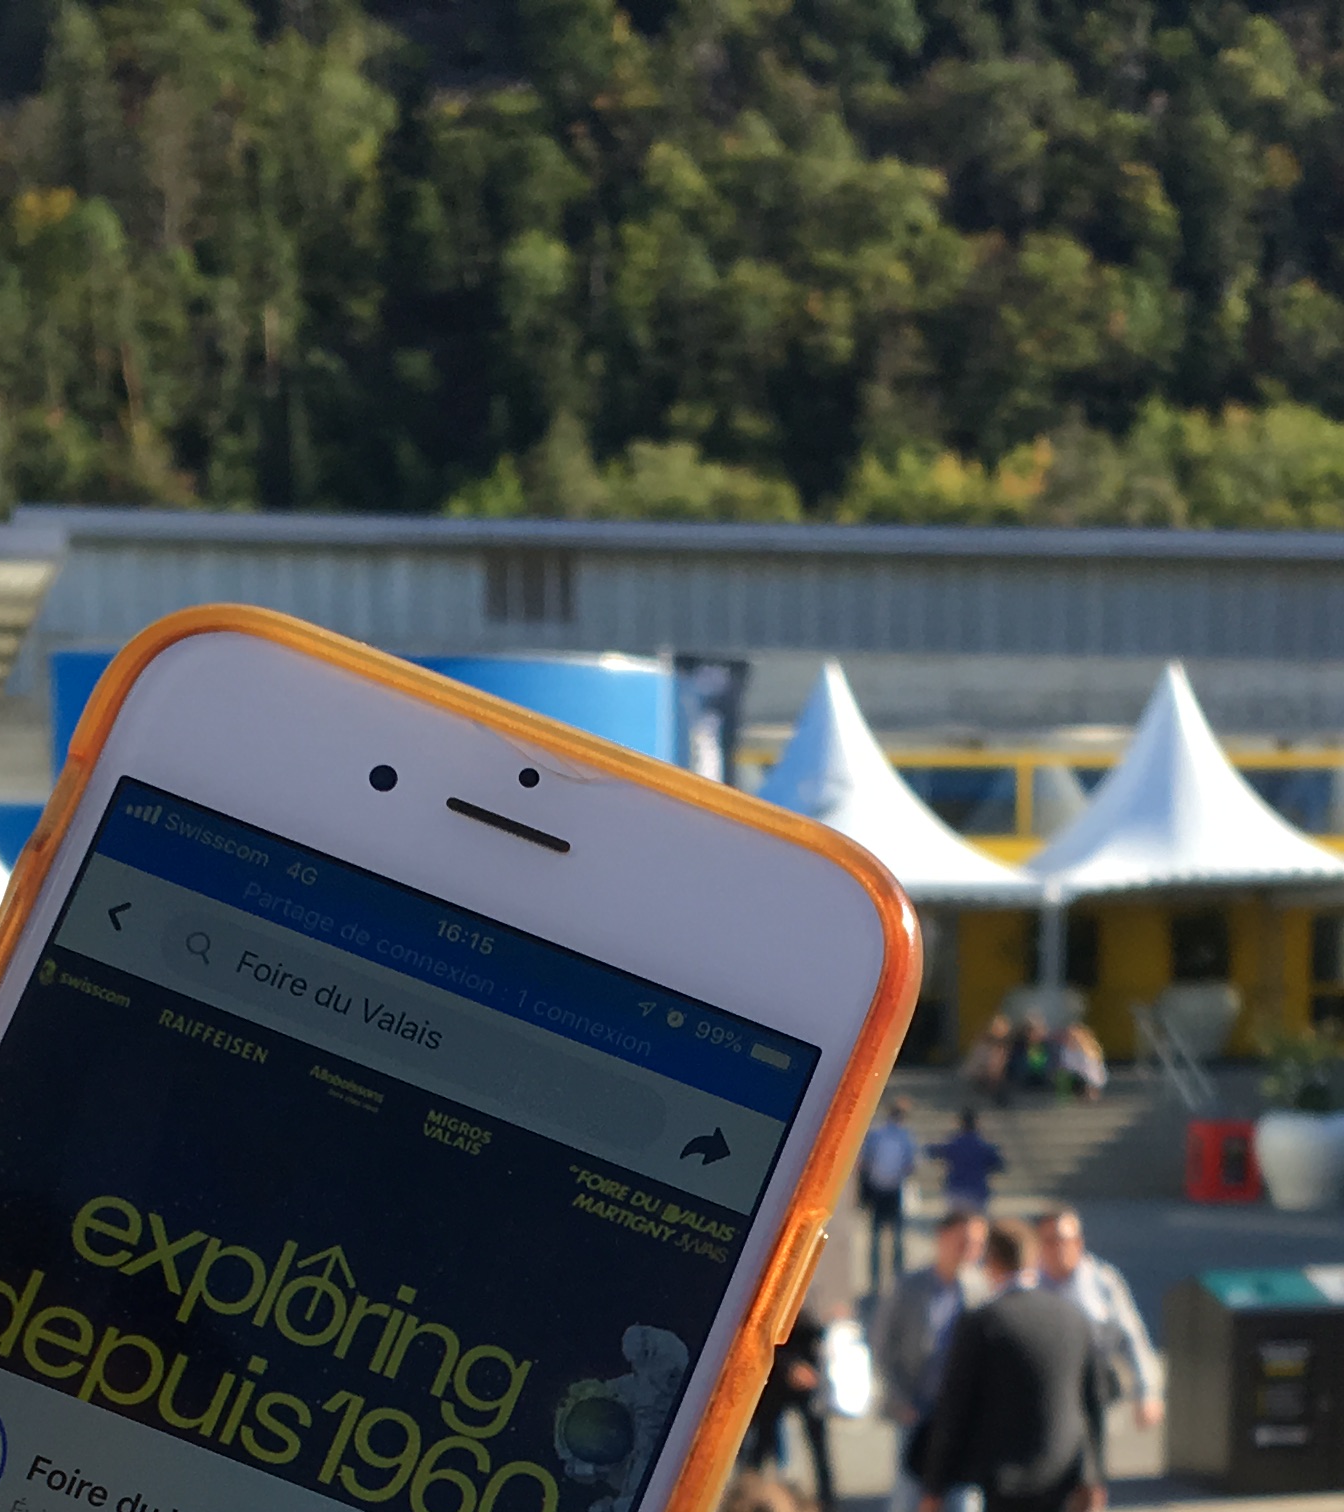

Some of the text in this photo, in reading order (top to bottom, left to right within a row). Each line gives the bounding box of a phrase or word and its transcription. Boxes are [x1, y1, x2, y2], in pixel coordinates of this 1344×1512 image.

[164, 812, 319, 886] Swisscom 4G
[436, 919, 496, 955] 16:15
[58, 970, 131, 1008] swisscom
[242, 881, 334, 931] Partage
[340, 922, 371, 947] de
[376, 938, 495, 995] connexion
[533, 1000, 652, 1056] connexion
[236, 950, 444, 1050] Foire du Valais
[158, 1008, 270, 1064] RAIFFEISEN
[694, 1020, 743, 1053] 99%
[423, 1123, 483, 1155] VALAIS
[426, 1109, 493, 1144] MIGROS
[572, 1193, 677, 1242] MARTIGNY
[630, 1190, 661, 1213] DU
[26, 1455, 108, 1507] Foire
